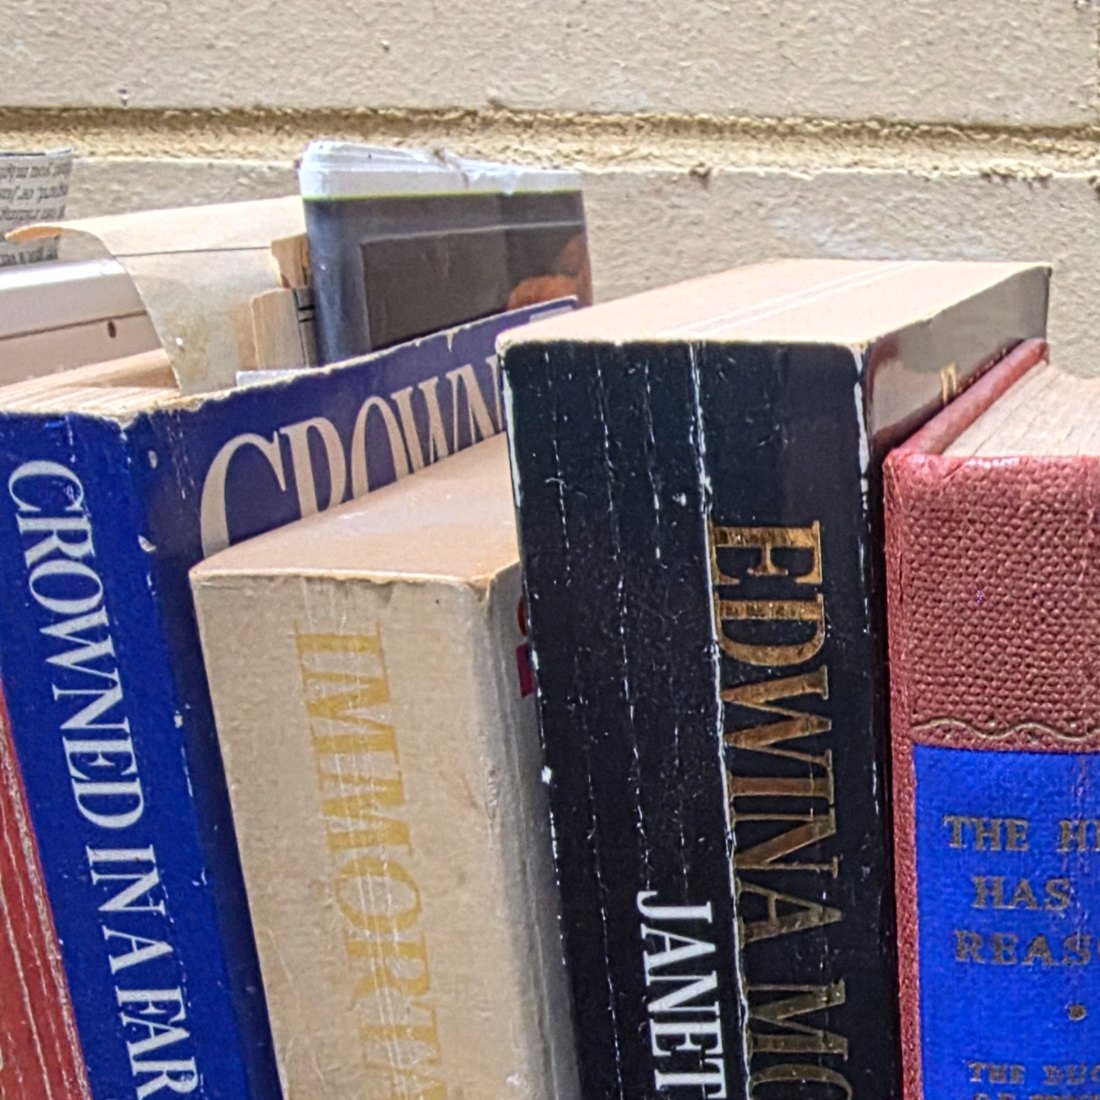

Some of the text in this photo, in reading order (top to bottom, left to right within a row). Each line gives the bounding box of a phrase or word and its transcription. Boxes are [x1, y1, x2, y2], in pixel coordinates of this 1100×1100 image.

[200, 354, 509, 560] CROW
[8, 459, 145, 830] CROWNED
[711, 520, 843, 949] EDWINA
[943, 814, 1030, 852] THE
[86, 844, 167, 917] IN
[971, 874, 1072, 911] HAS
[102, 924, 174, 975] A
[637, 890, 728, 1100] JANET
[967, 1060, 1026, 1085] THE
